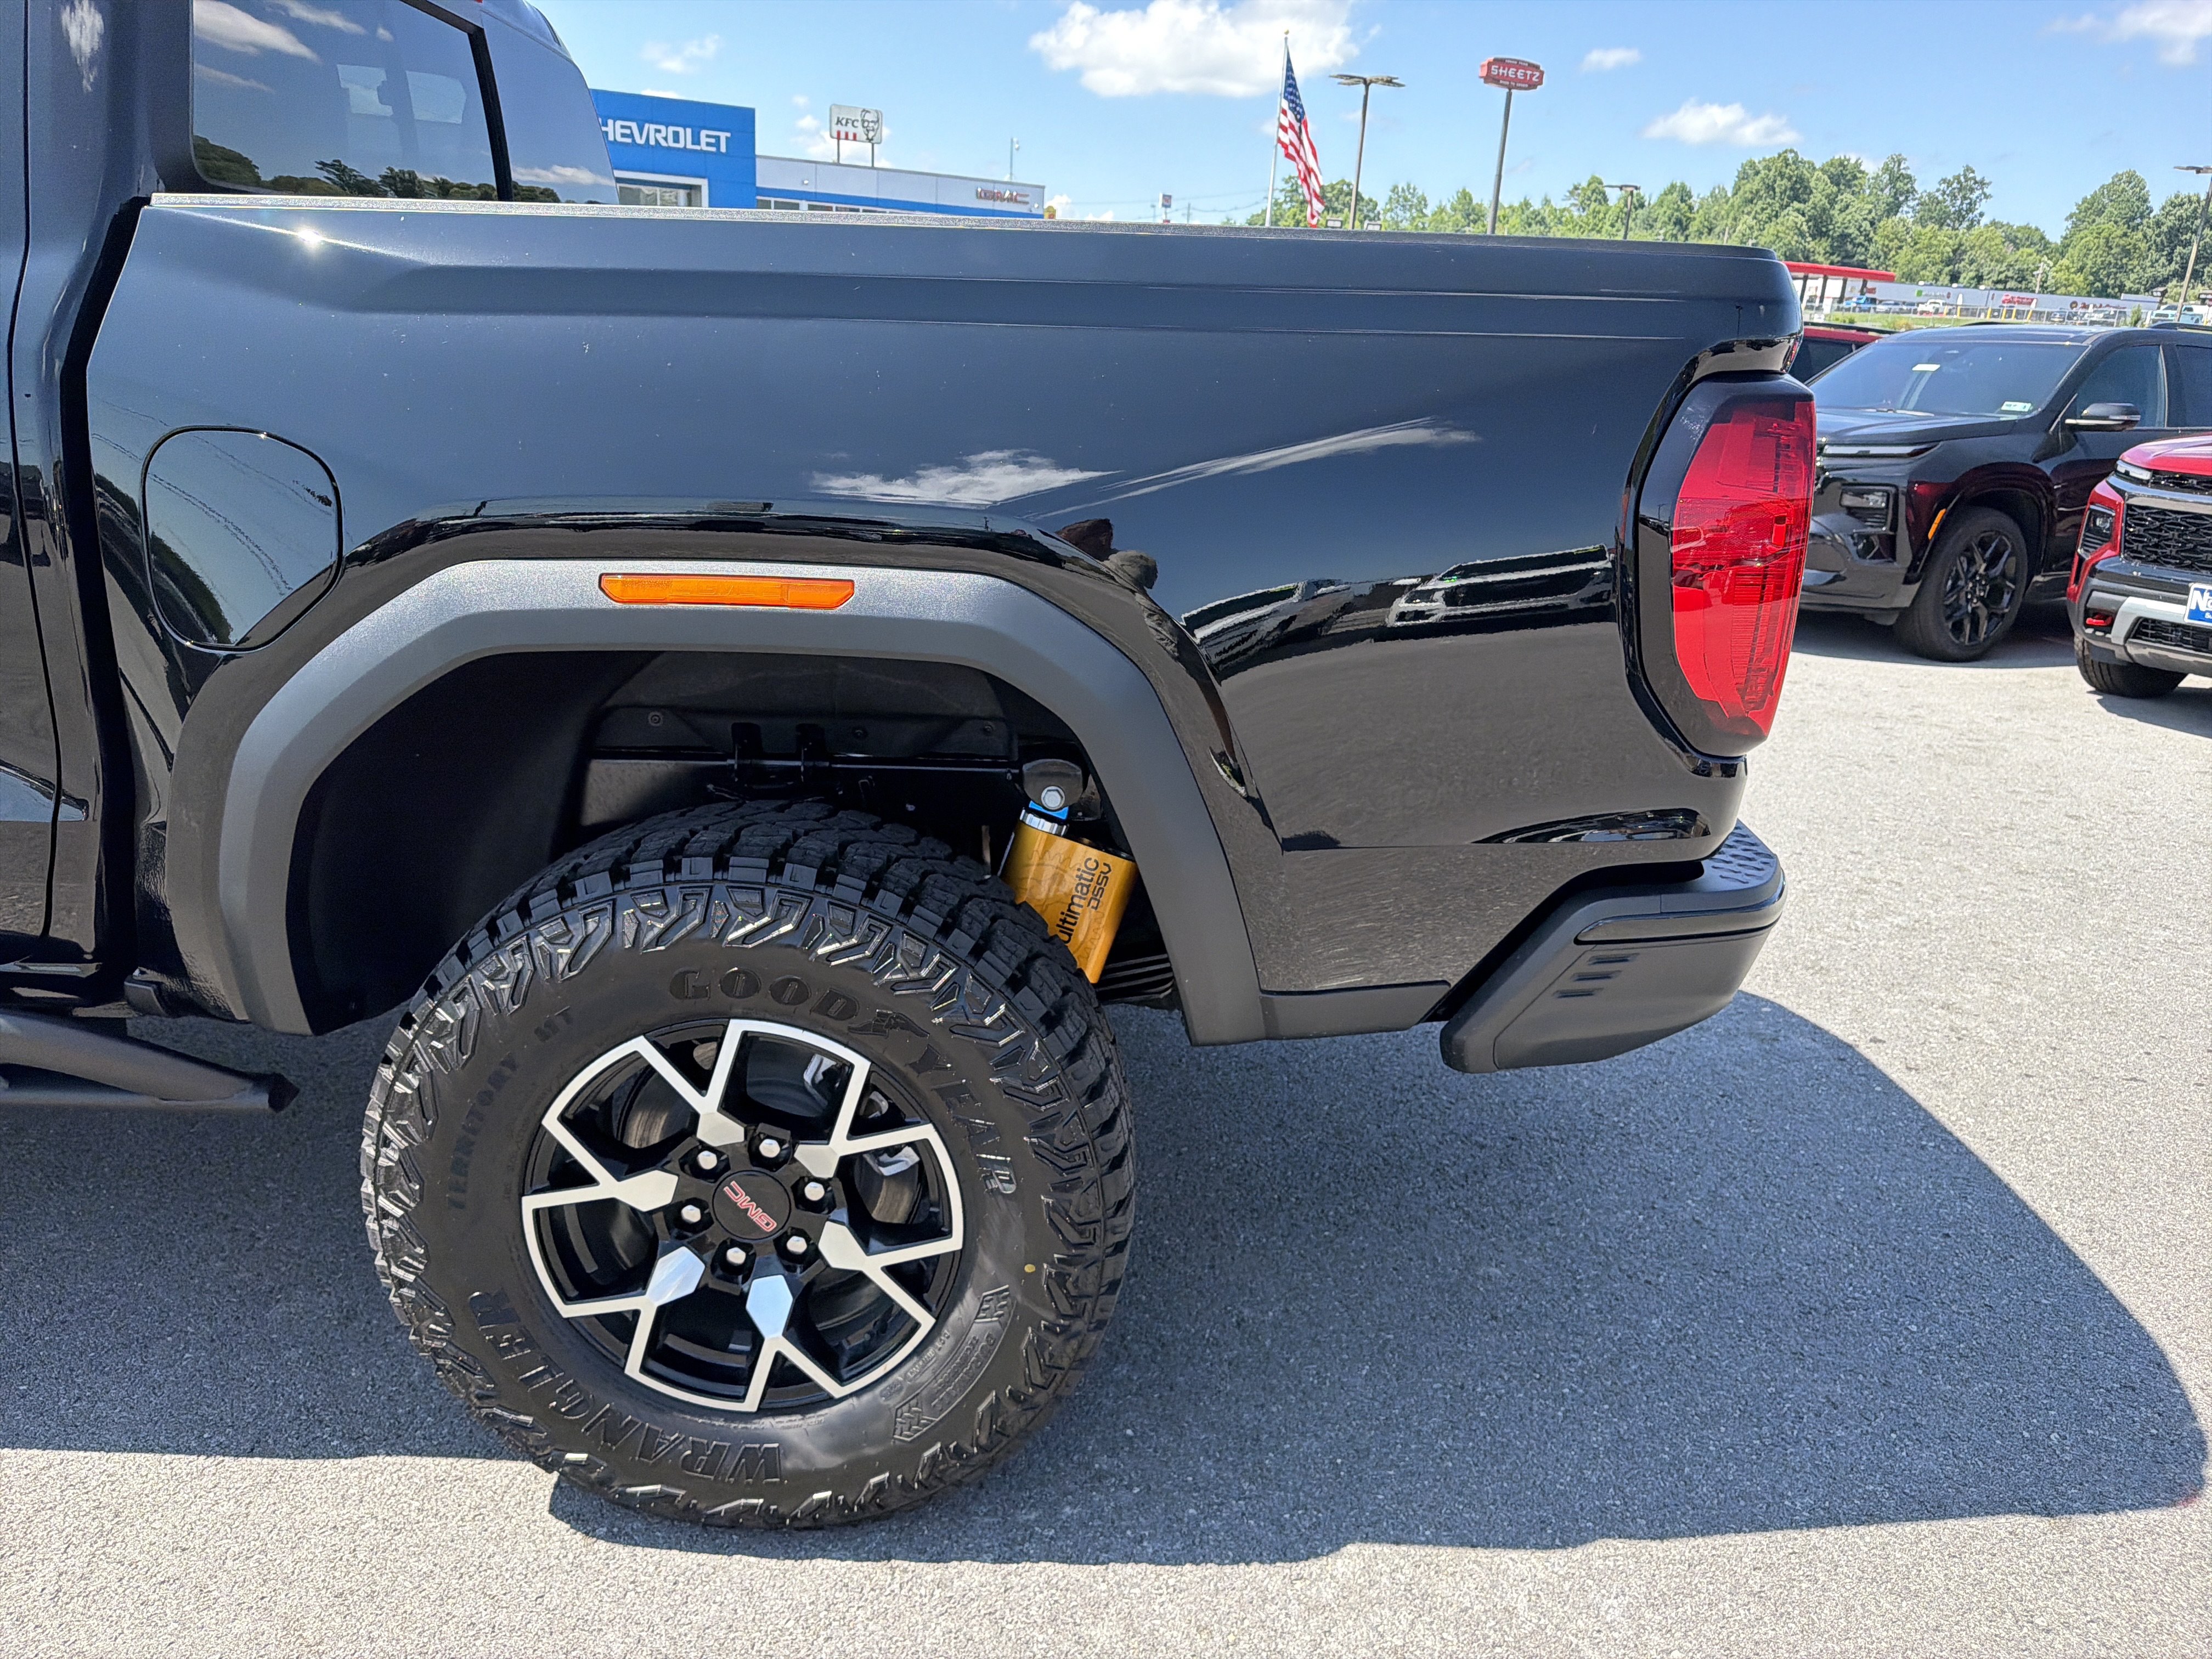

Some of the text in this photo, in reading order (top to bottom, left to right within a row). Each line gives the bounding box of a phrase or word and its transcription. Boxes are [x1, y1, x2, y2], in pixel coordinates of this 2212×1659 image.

[1491, 65, 1540, 82] SHEETZ
[599, 117, 731, 153] HEVROLET
[836, 116, 860, 128] KFC
[1056, 857, 1099, 944] ultimatic
[1087, 862, 1112, 911] DSSV
[447, 1052, 518, 1210] TERRITORY
[724, 1180, 777, 1232] GMC
[469, 1290, 783, 1483] WRANGLER
